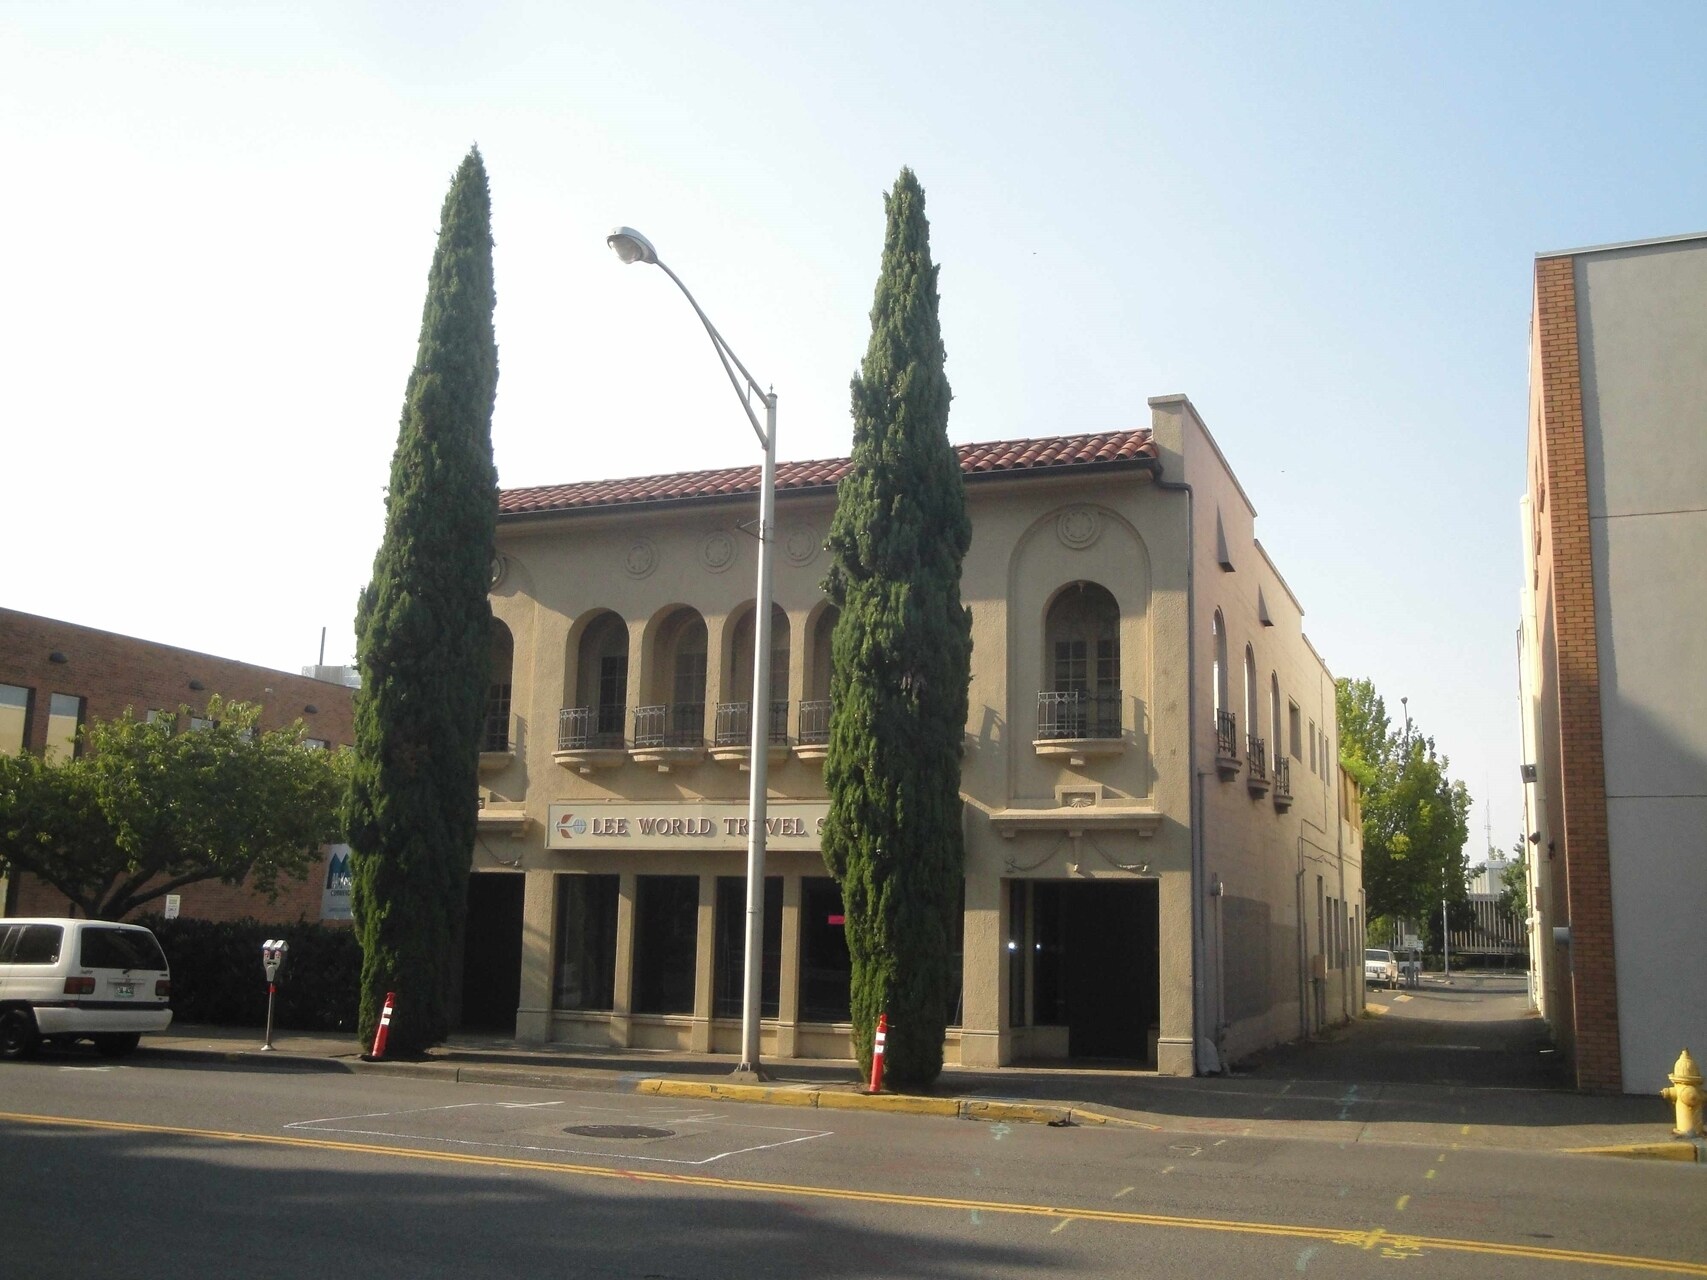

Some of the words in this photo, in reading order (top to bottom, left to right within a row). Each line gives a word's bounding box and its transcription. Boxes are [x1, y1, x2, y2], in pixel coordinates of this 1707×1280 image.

[591, 817, 627, 835] LEE
[636, 817, 712, 835] WORLD
[723, 817, 805, 836] TRVEL
